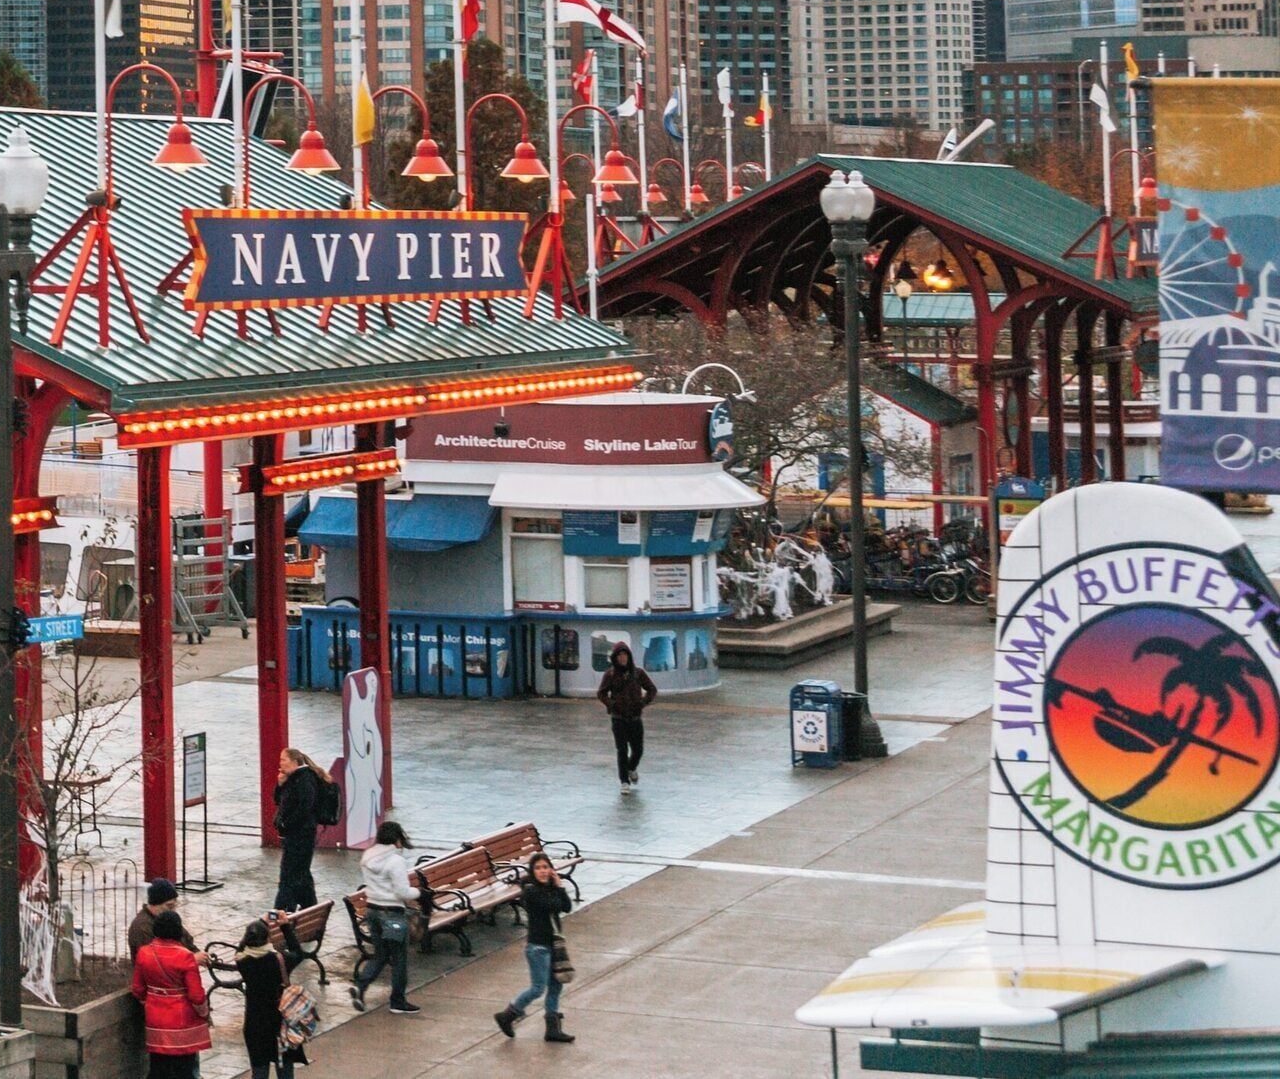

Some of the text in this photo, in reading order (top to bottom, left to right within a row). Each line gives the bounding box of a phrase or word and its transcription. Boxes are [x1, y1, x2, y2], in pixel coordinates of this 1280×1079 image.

[1142, 228, 1160, 254] NA
[231, 232, 505, 286] NAVY PIER
[434, 433, 567, 451] ArchitectureCruise
[584, 438, 699, 455] Skyline LakeTour
[45, 619, 77, 637] STREET
[999, 588, 1070, 737] JIMMY
